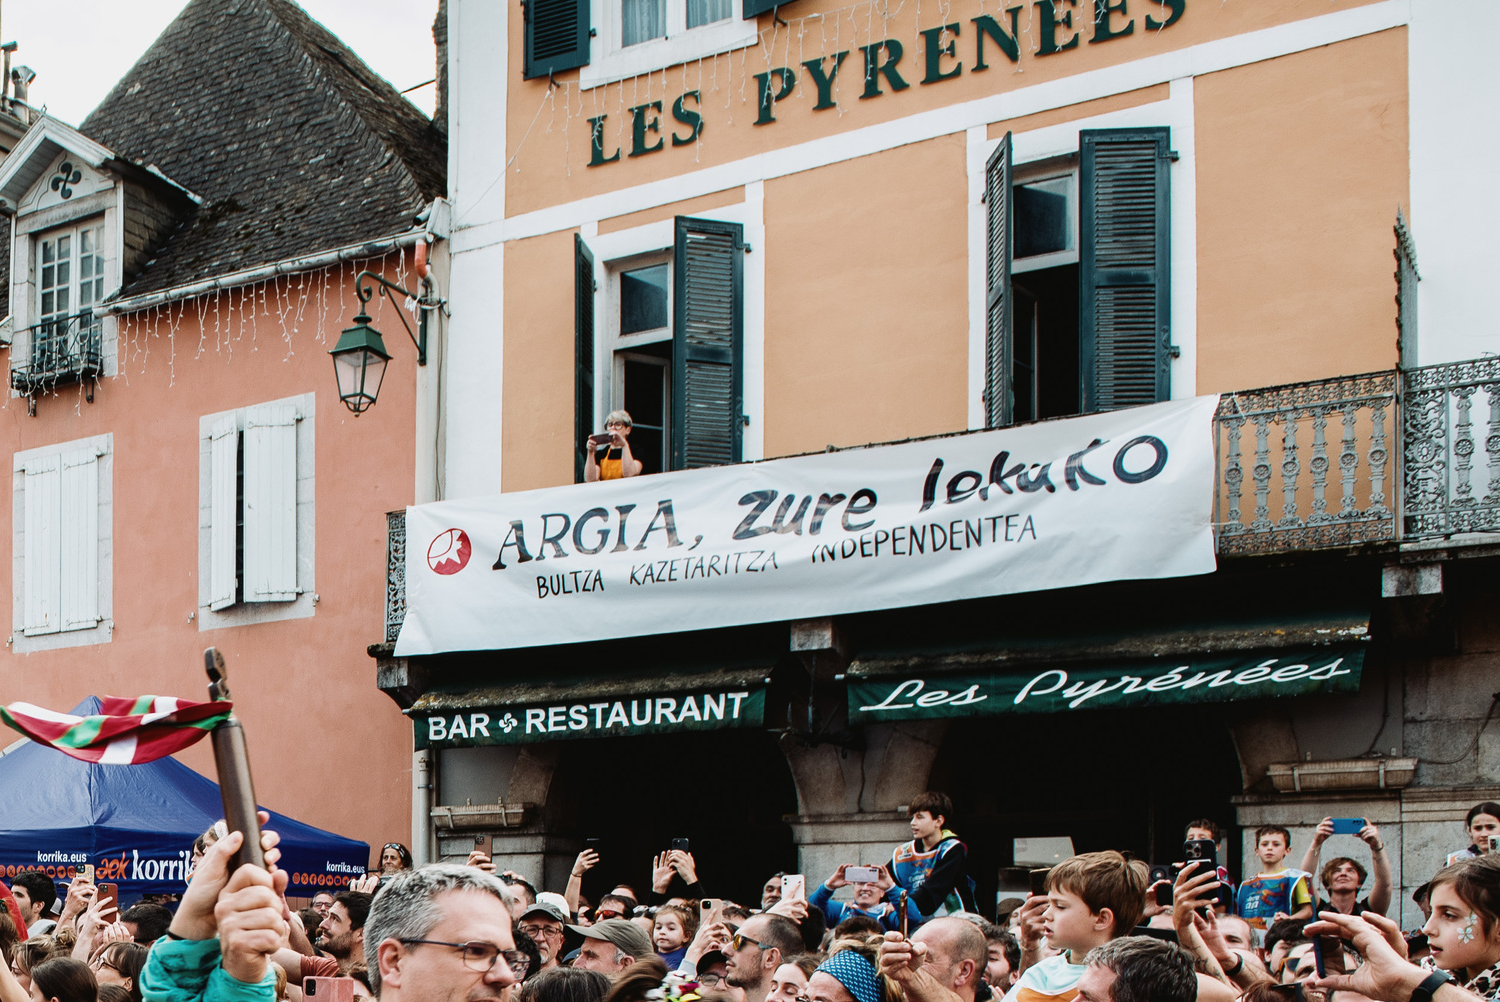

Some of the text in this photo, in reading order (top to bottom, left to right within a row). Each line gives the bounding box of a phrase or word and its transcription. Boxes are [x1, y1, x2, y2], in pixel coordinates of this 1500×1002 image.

[587, 90, 704, 168] LES
[492, 498, 704, 571] ARGIA,
[535, 513, 1037, 600] BULTZA KAZETARITZA INDEPENDENTEA
[859, 655, 1352, 712] Les Pyrénées
[428, 690, 749, 742] BAR RESTAURANT
[37, 850, 87, 864] korrika.eus
[95, 849, 195, 881] aek korrik
[326, 860, 366, 875] korrika.eus
